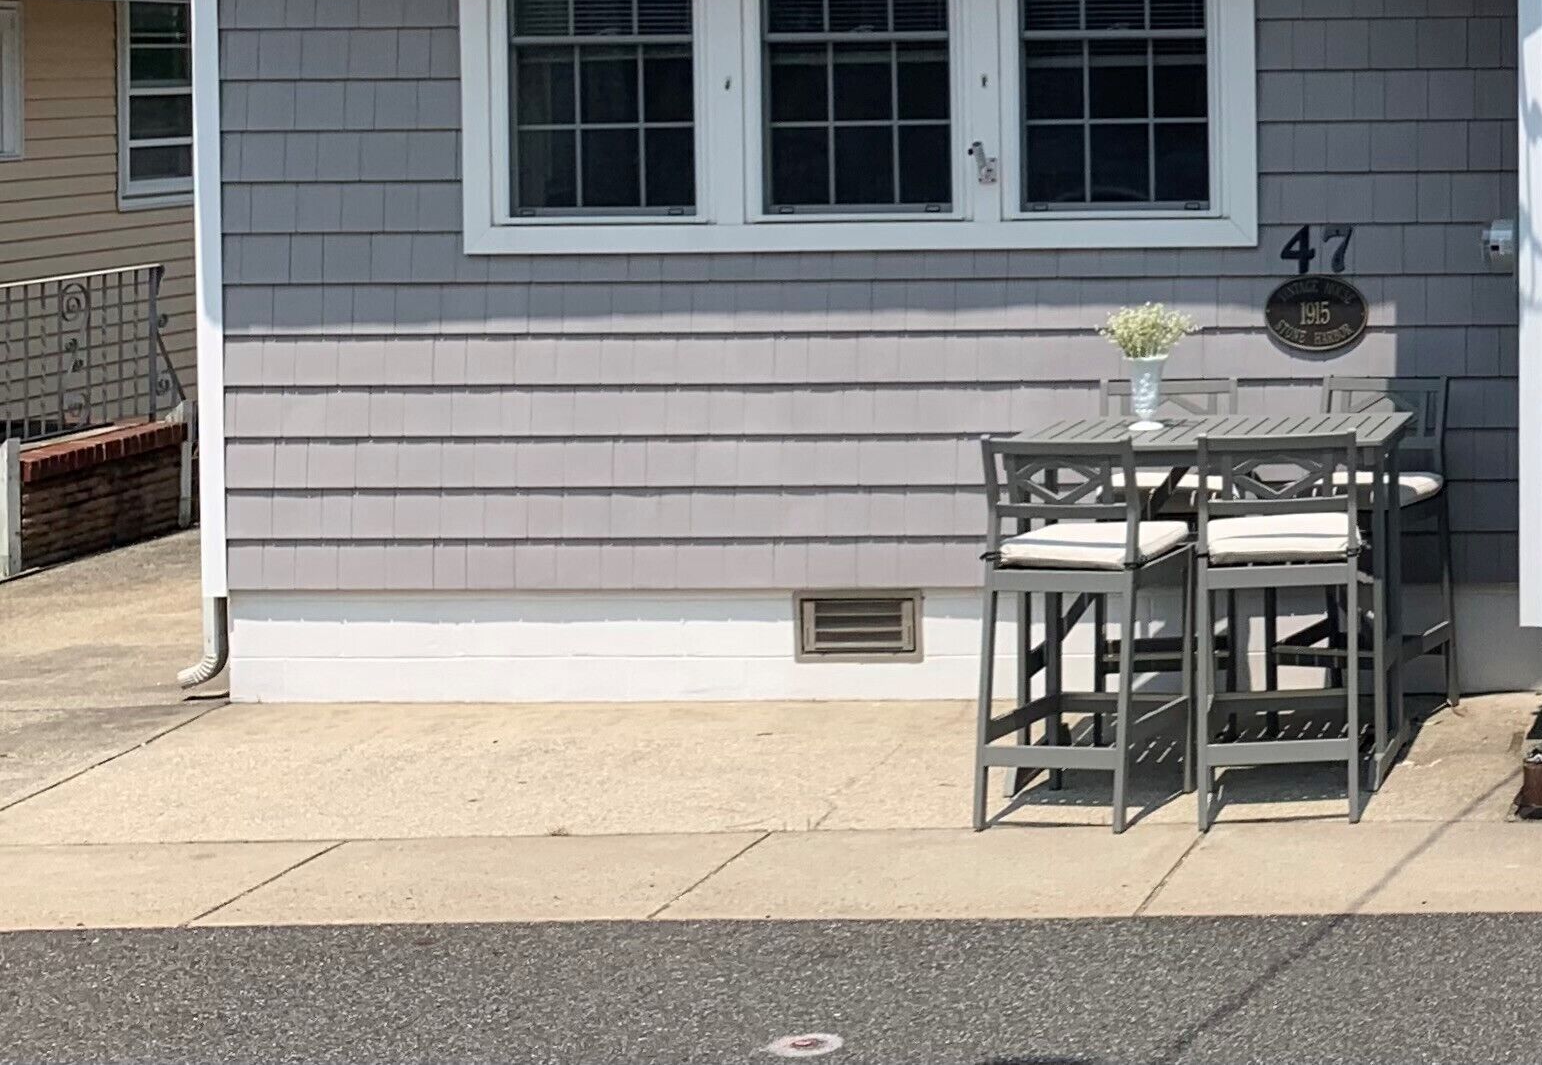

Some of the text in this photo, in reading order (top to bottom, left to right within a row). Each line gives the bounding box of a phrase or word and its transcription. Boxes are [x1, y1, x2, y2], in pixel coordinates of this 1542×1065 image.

[1280, 224, 1353, 274] 47
[1299, 301, 1331, 325] 1915
[1274, 319, 1355, 345] STONE HARBOR
